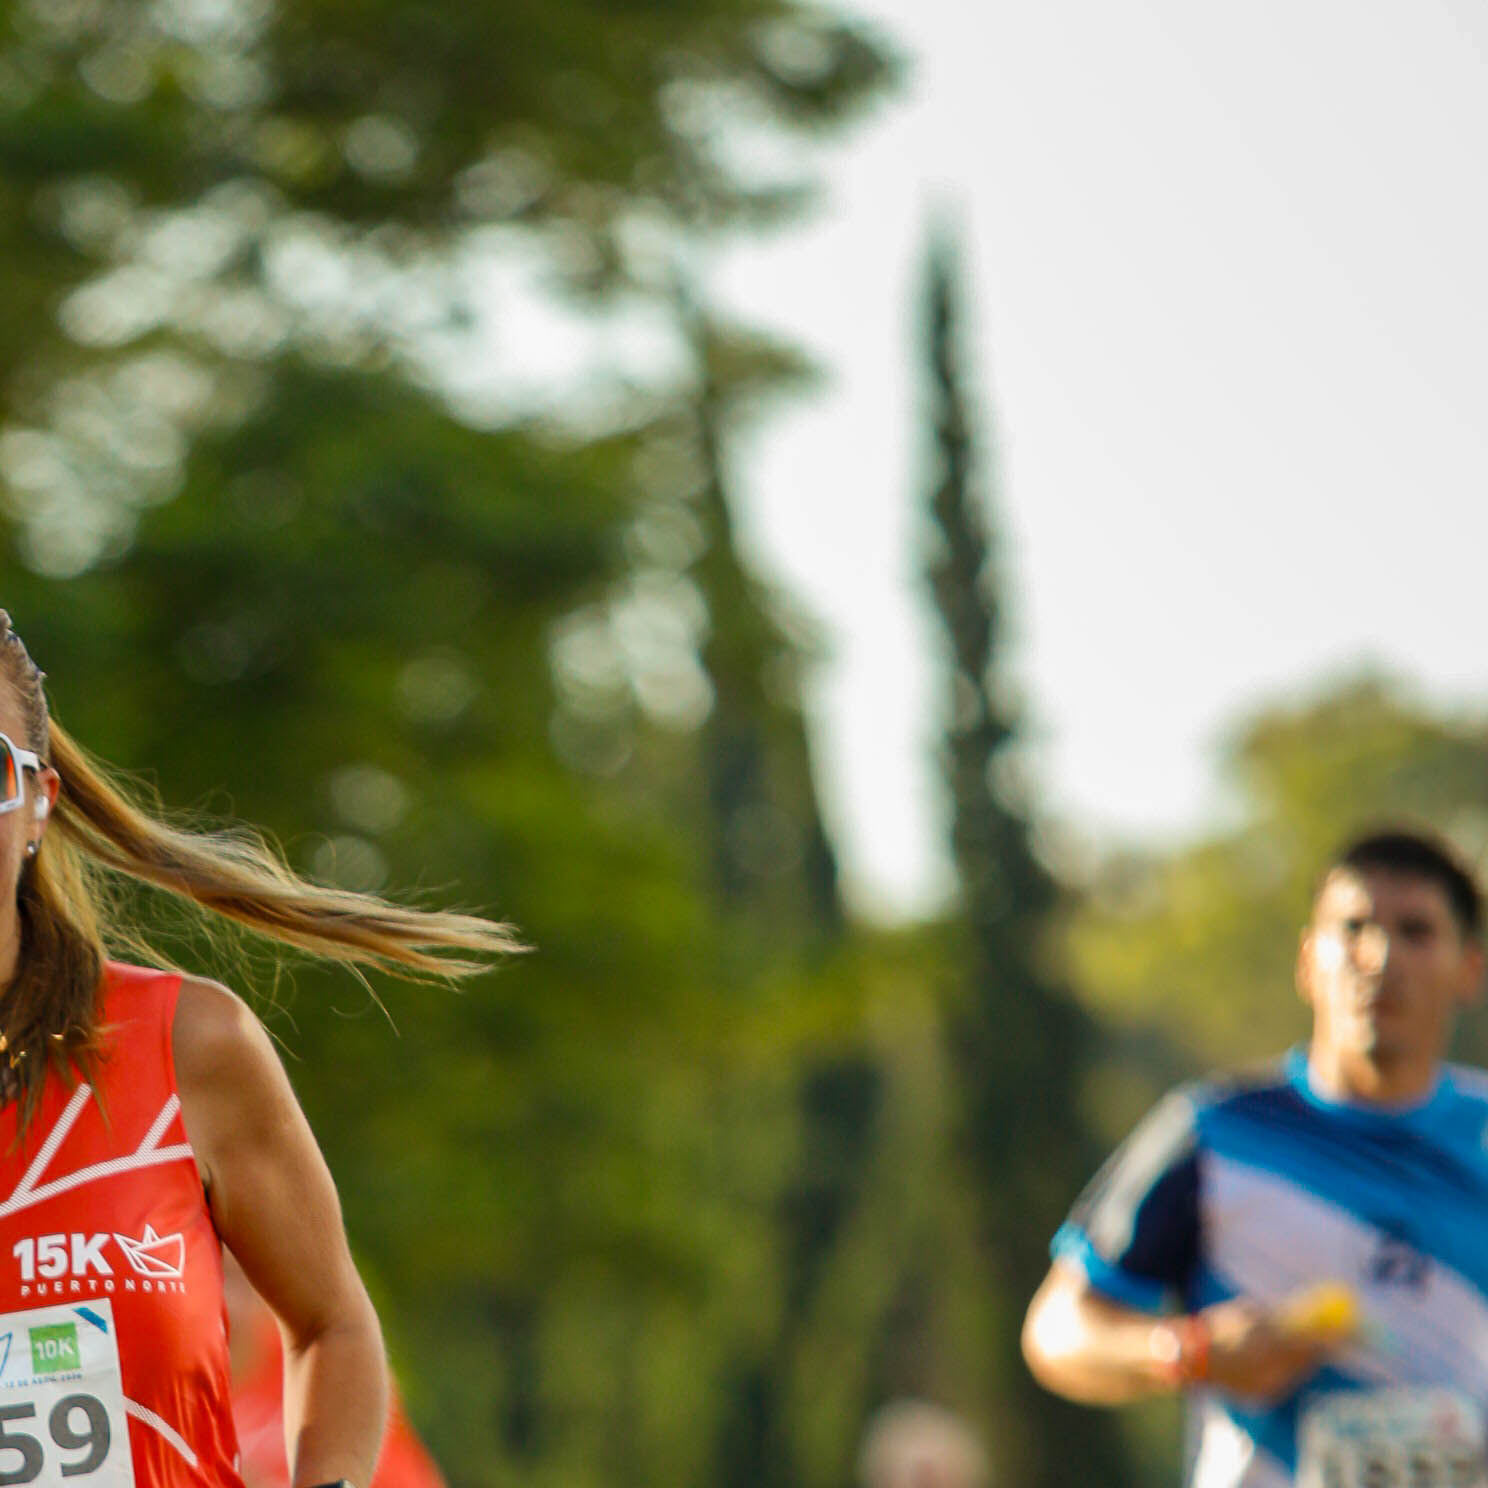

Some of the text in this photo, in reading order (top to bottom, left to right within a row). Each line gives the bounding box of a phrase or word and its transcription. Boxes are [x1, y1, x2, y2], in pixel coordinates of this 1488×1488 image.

[13, 1233, 114, 1281] 15K
[21, 1279, 114, 1296] PUERTO
[35, 1336, 76, 1361] 10K
